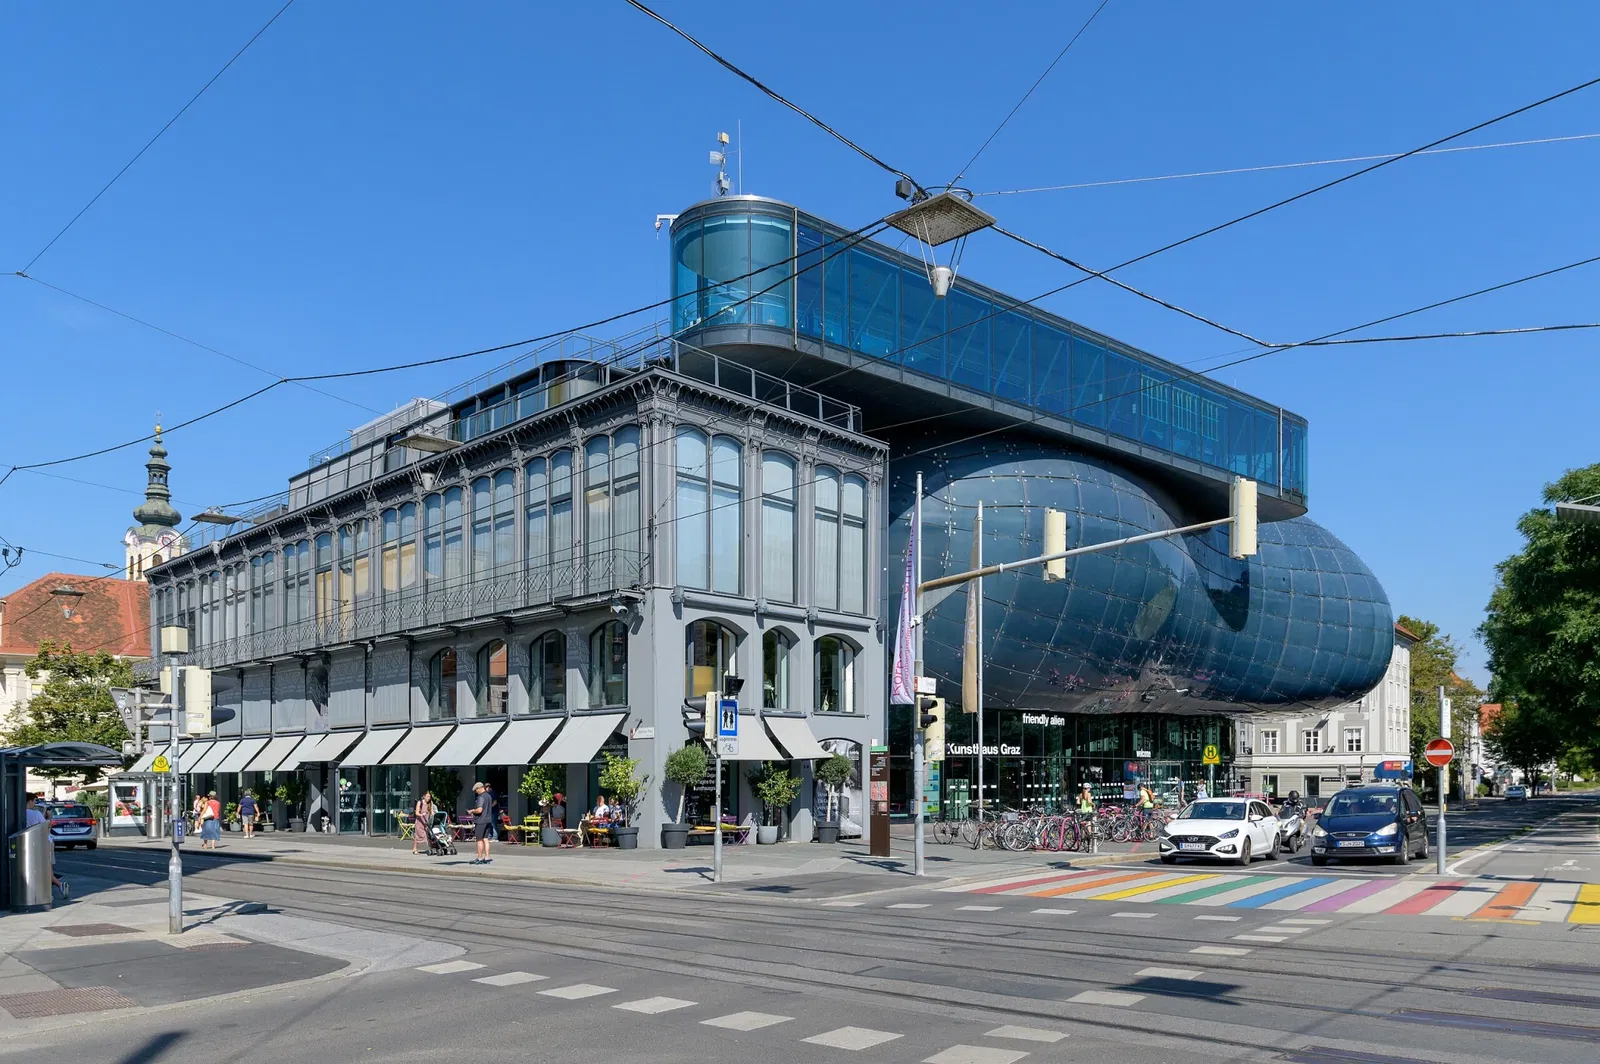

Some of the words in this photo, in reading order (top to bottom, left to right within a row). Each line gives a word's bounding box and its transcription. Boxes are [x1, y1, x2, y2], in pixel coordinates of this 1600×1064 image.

[1022, 712, 1050, 727] friendly
[1050, 714, 1065, 726] alien
[1000, 743, 1021, 755] Graz
[1207, 746, 1214, 757] H
